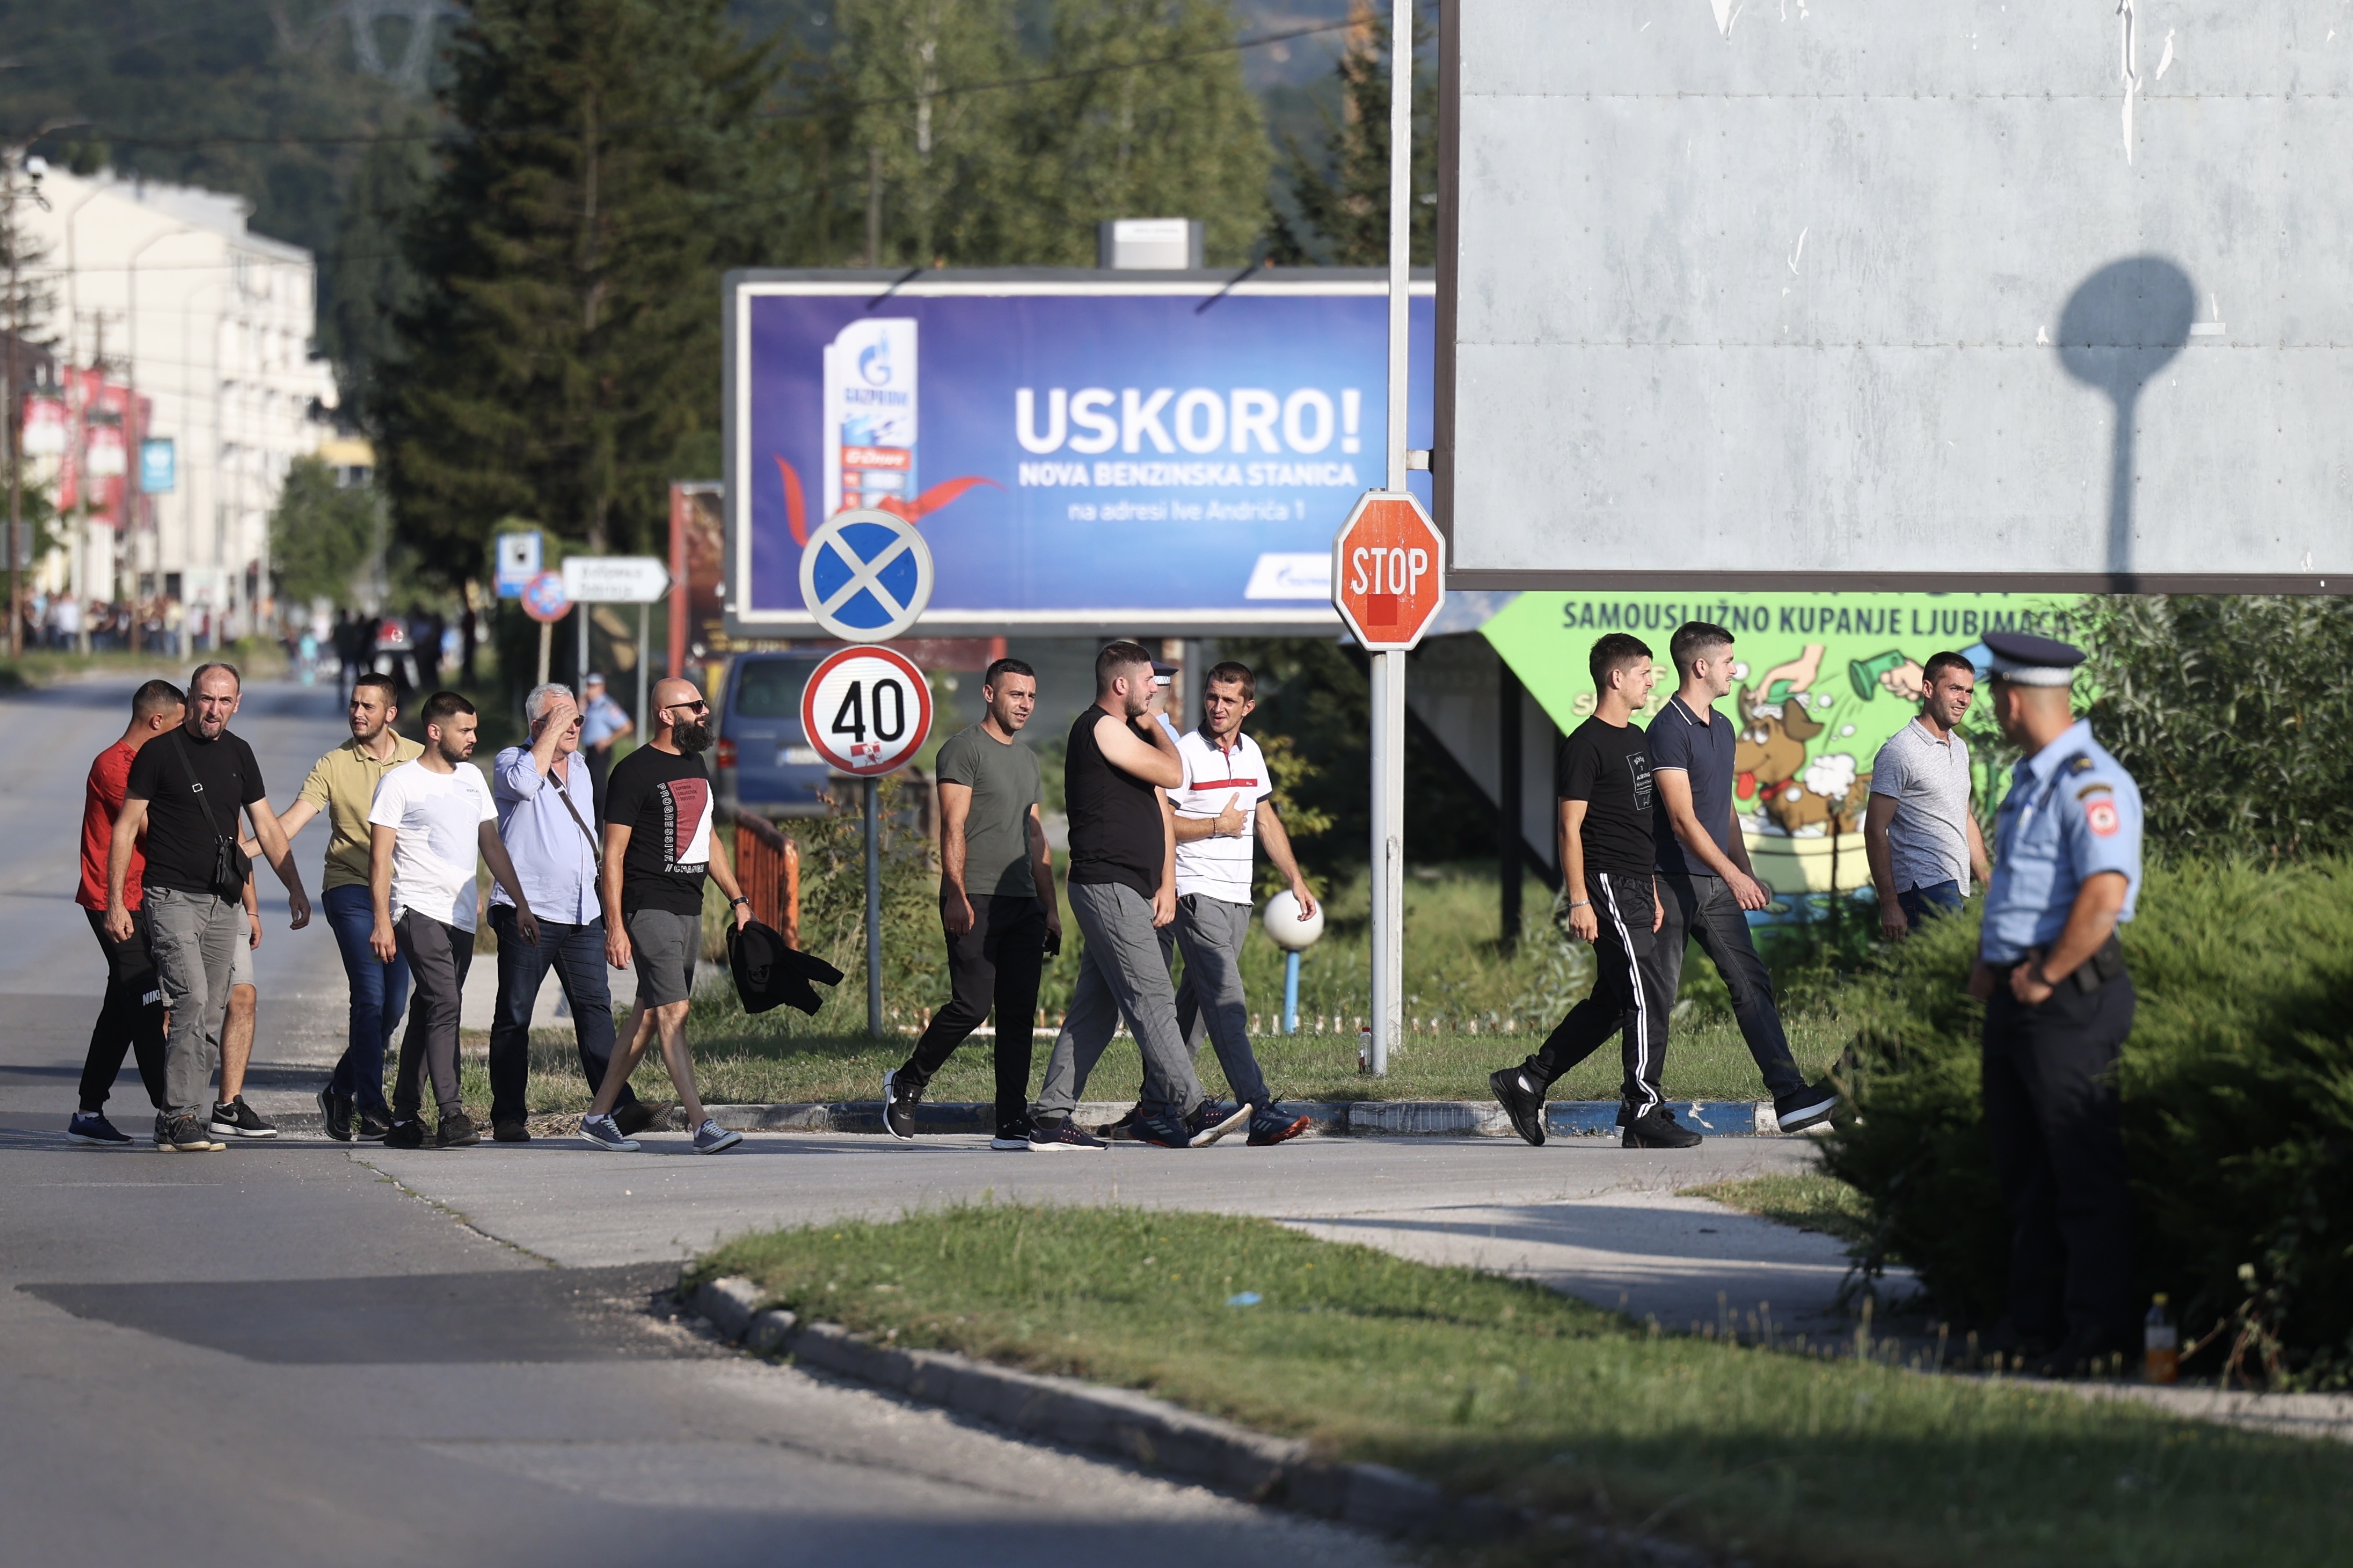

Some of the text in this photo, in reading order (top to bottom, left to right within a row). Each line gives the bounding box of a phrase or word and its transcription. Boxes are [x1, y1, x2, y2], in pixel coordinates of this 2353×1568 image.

[1016, 388, 1362, 454] USKORO!
[1019, 462, 1358, 487] NOVA BENZINSKA STANICA
[1068, 503, 1097, 521] na
[1100, 499, 1167, 521] adresi
[1171, 500, 1203, 521] Ive
[1294, 500, 1305, 521] 1
[1352, 547, 1428, 595] STOP
[1780, 606, 1902, 635] KUPANJE
[832, 678, 905, 743] 40
[657, 783, 674, 862] PROGRESSIVE
